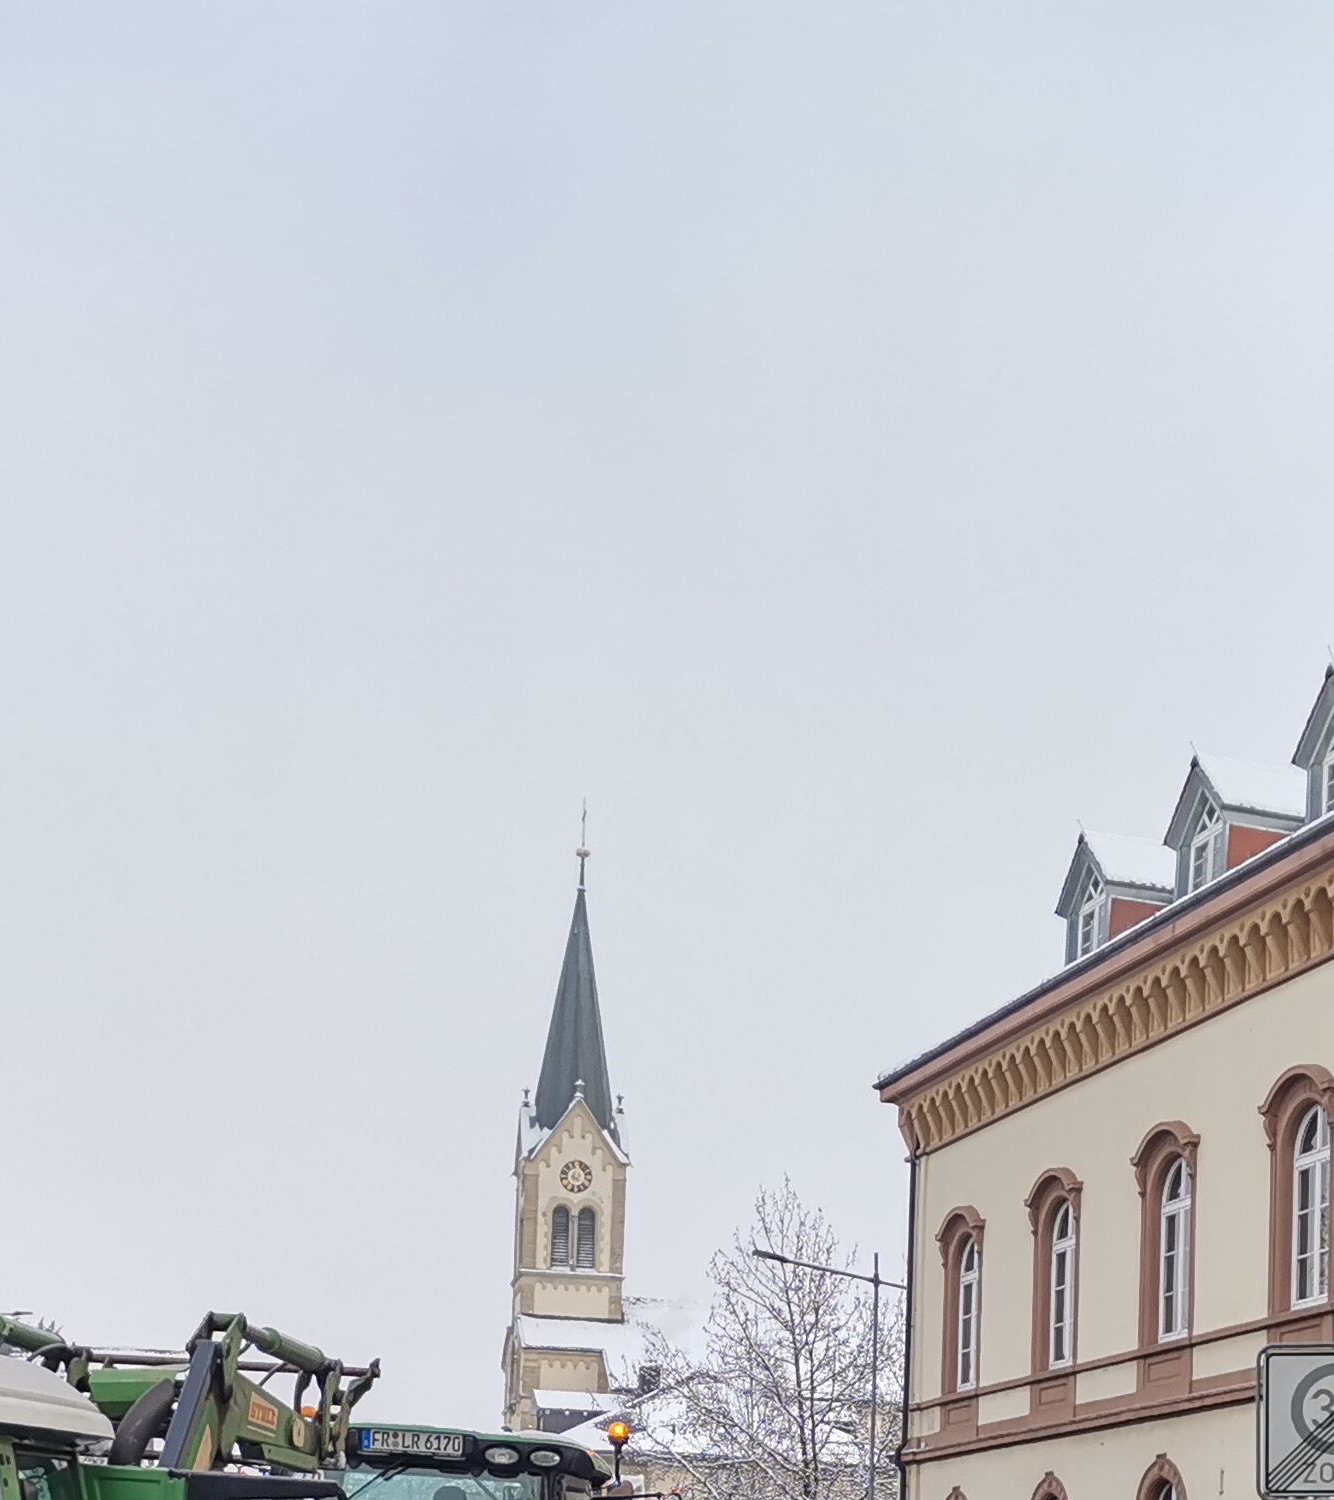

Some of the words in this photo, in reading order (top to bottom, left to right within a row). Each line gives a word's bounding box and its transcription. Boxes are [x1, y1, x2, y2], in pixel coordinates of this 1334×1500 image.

[371, 1431, 391, 1448] FR
[402, 1433, 421, 1450] LR
[424, 1434, 462, 1453] 6170
